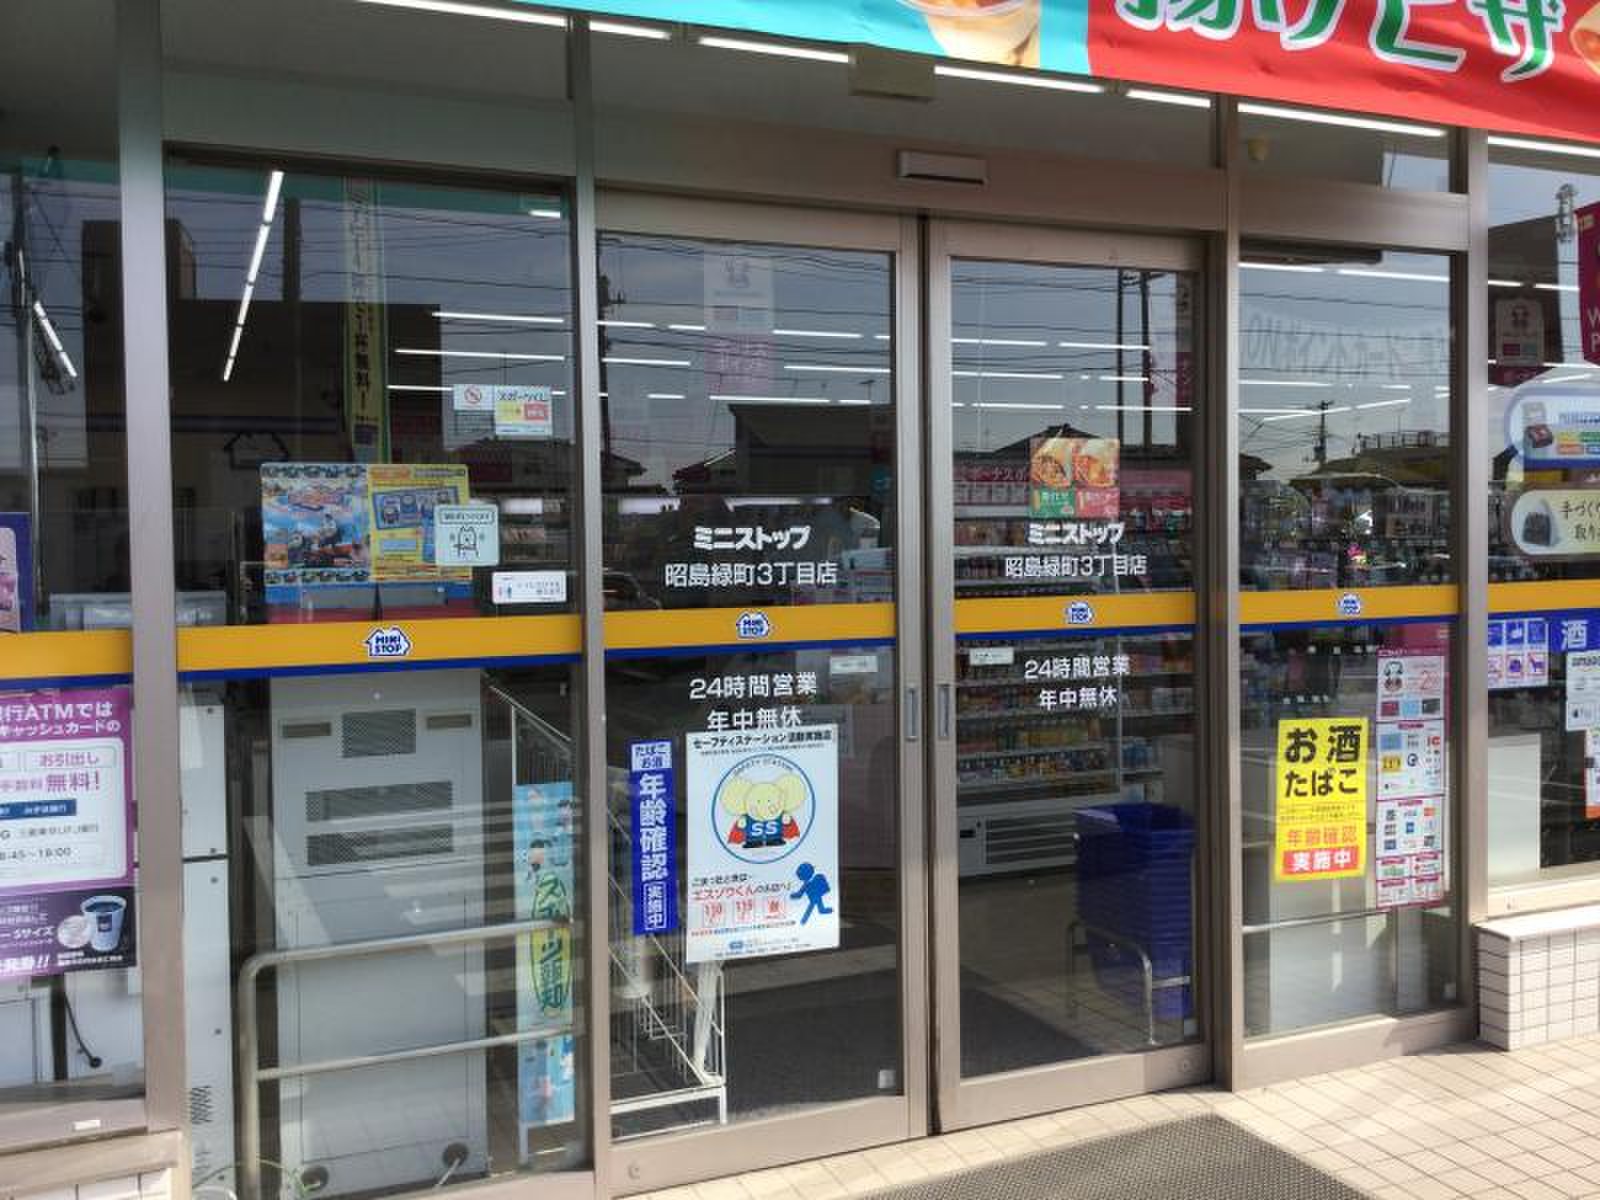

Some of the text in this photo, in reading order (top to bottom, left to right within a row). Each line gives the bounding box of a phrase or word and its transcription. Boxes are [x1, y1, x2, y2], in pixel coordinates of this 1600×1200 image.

[694, 525, 812, 551] ミニストップ
[1027, 522, 1125, 545] ミニストップ
[664, 562, 838, 588] 昭島緑町3丁目店
[1561, 620, 1589, 650] 酒
[374, 644, 402, 653] STOP
[1024, 655, 1131, 680] 24時間営業
[689, 672, 817, 700] 24時間営業
[1039, 685, 1118, 712] 年中無休
[706, 705, 803, 733] 年中無休
[1285, 725, 1362, 763] お酒
[1285, 768, 1359, 798] たばこ
[640, 773, 668, 882] 年齢確認
[751, 821, 778, 836] SS
[1286, 826, 1357, 846] 年齢確認
[1293, 850, 1351, 872] 実施中
